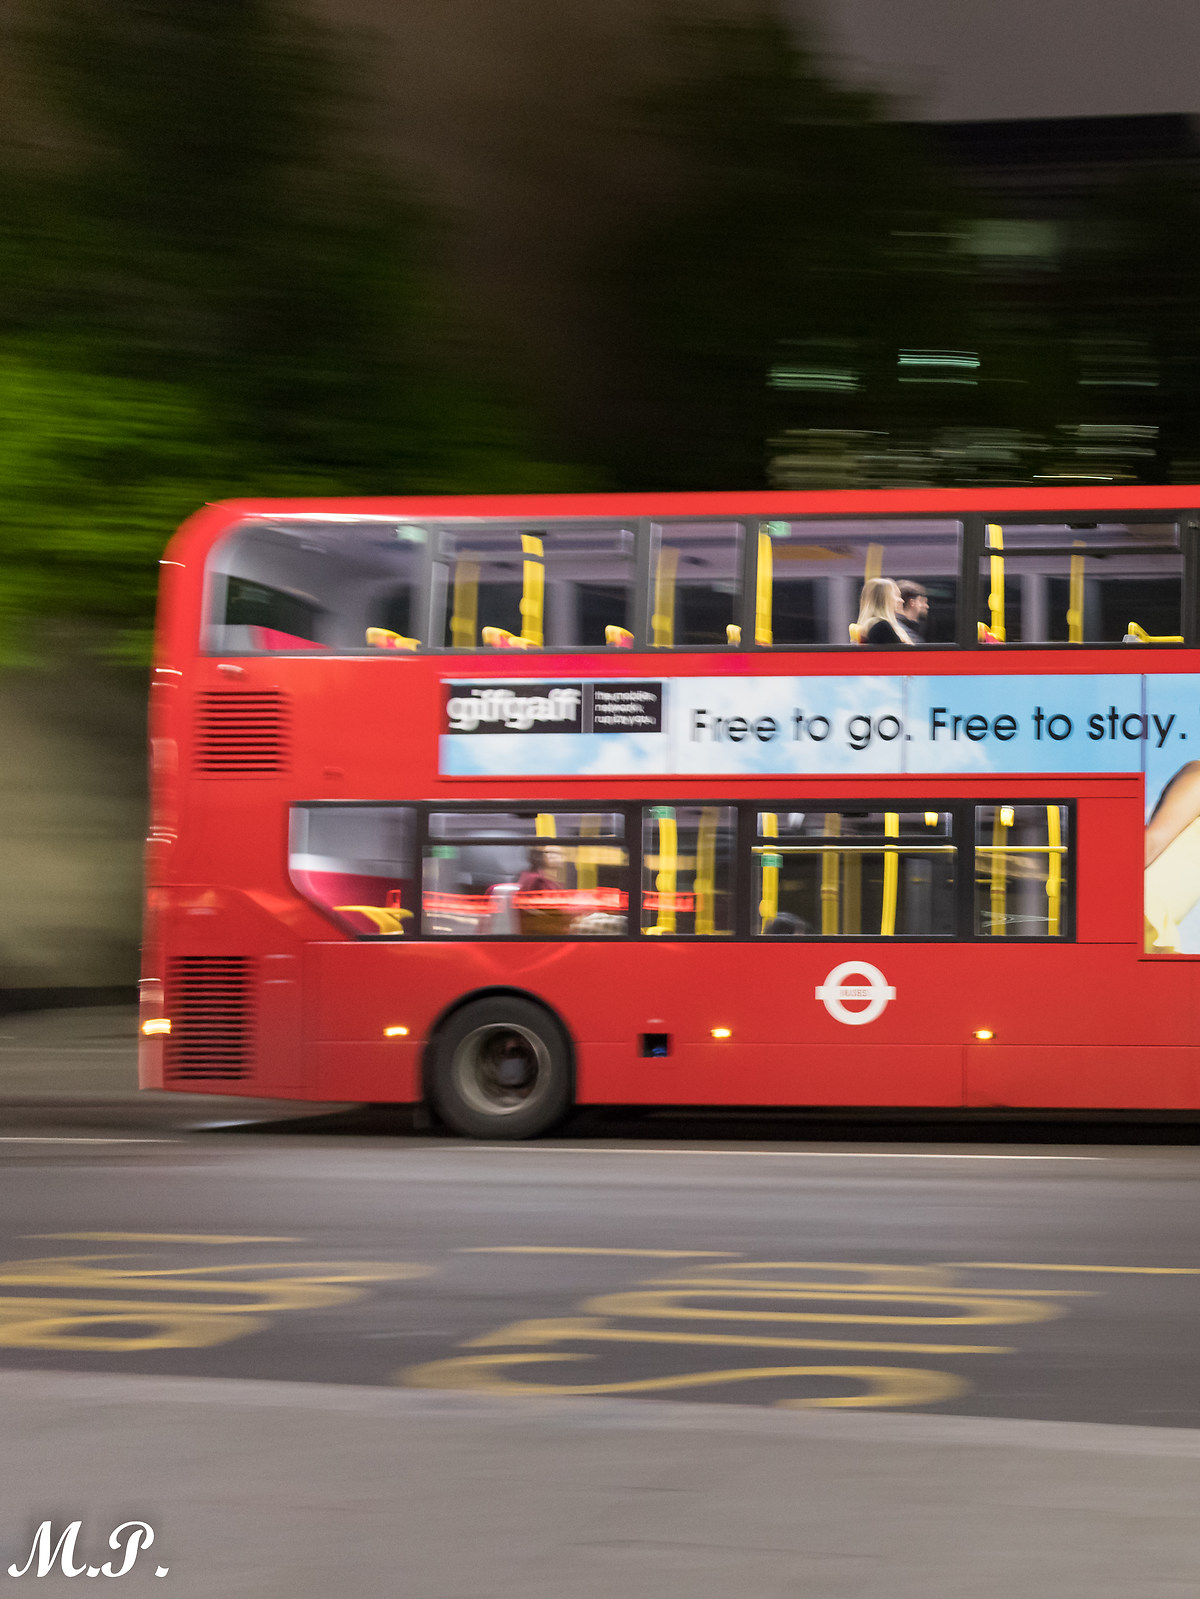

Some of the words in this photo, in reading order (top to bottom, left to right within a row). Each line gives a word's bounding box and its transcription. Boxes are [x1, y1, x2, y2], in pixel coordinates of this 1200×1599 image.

[692, 707, 777, 743] Free
[792, 707, 831, 742] to
[848, 714, 913, 751] go.
[929, 707, 1019, 741] Free
[1031, 706, 1073, 741] to
[1086, 705, 1188, 749] stay.
